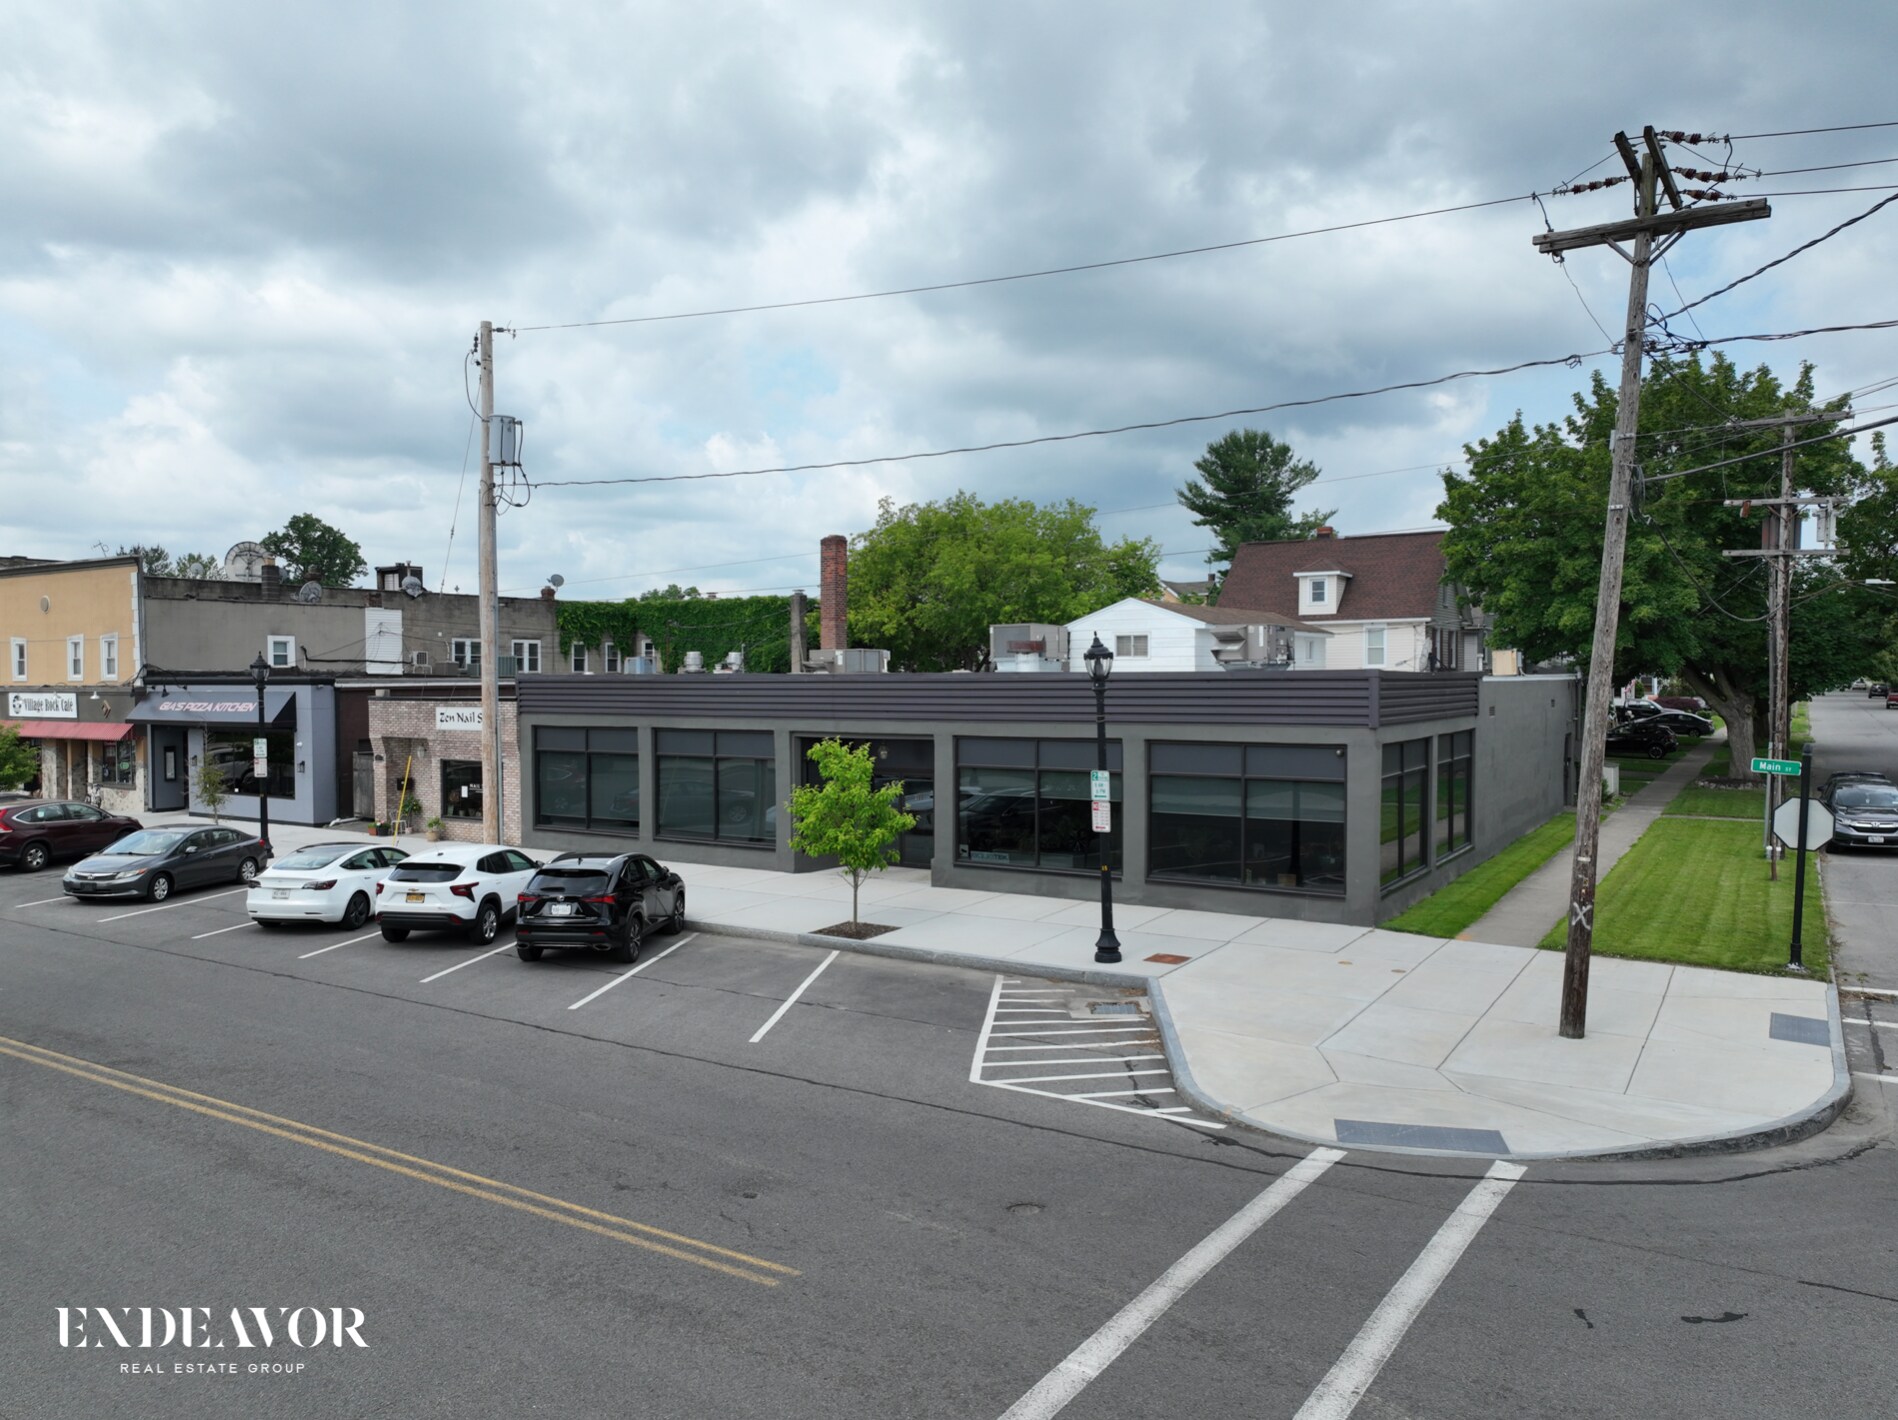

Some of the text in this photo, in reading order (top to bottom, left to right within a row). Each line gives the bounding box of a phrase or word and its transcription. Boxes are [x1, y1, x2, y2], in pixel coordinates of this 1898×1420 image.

[24, 698, 44, 713] Village
[45, 698, 60, 712] Rock
[182, 702, 213, 712] PIZZA
[213, 702, 257, 712] KITCHEN
[440, 712, 455, 723] Zen
[456, 711, 476, 723] Nail
[1759, 761, 1781, 771] Main
